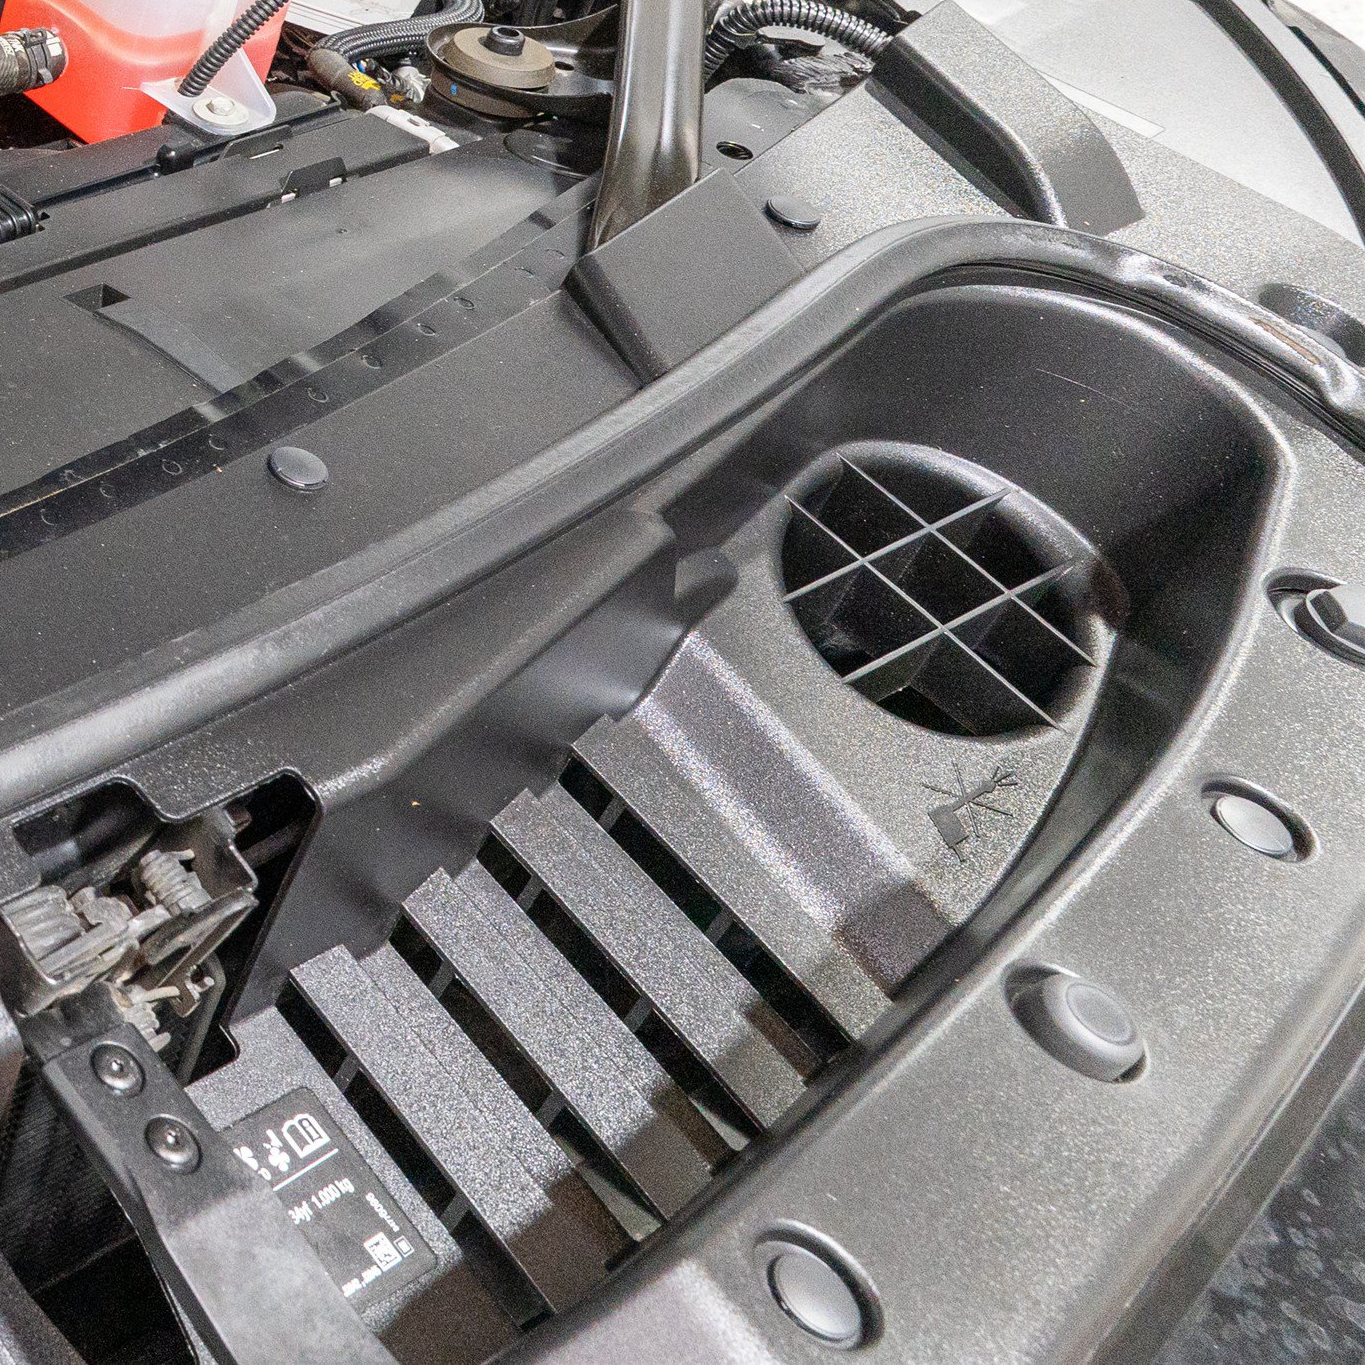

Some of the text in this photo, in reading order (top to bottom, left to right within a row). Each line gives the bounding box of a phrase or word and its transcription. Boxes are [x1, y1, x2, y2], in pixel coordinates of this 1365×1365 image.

[287, 1177, 355, 1225] 34yf 1.000 kg
